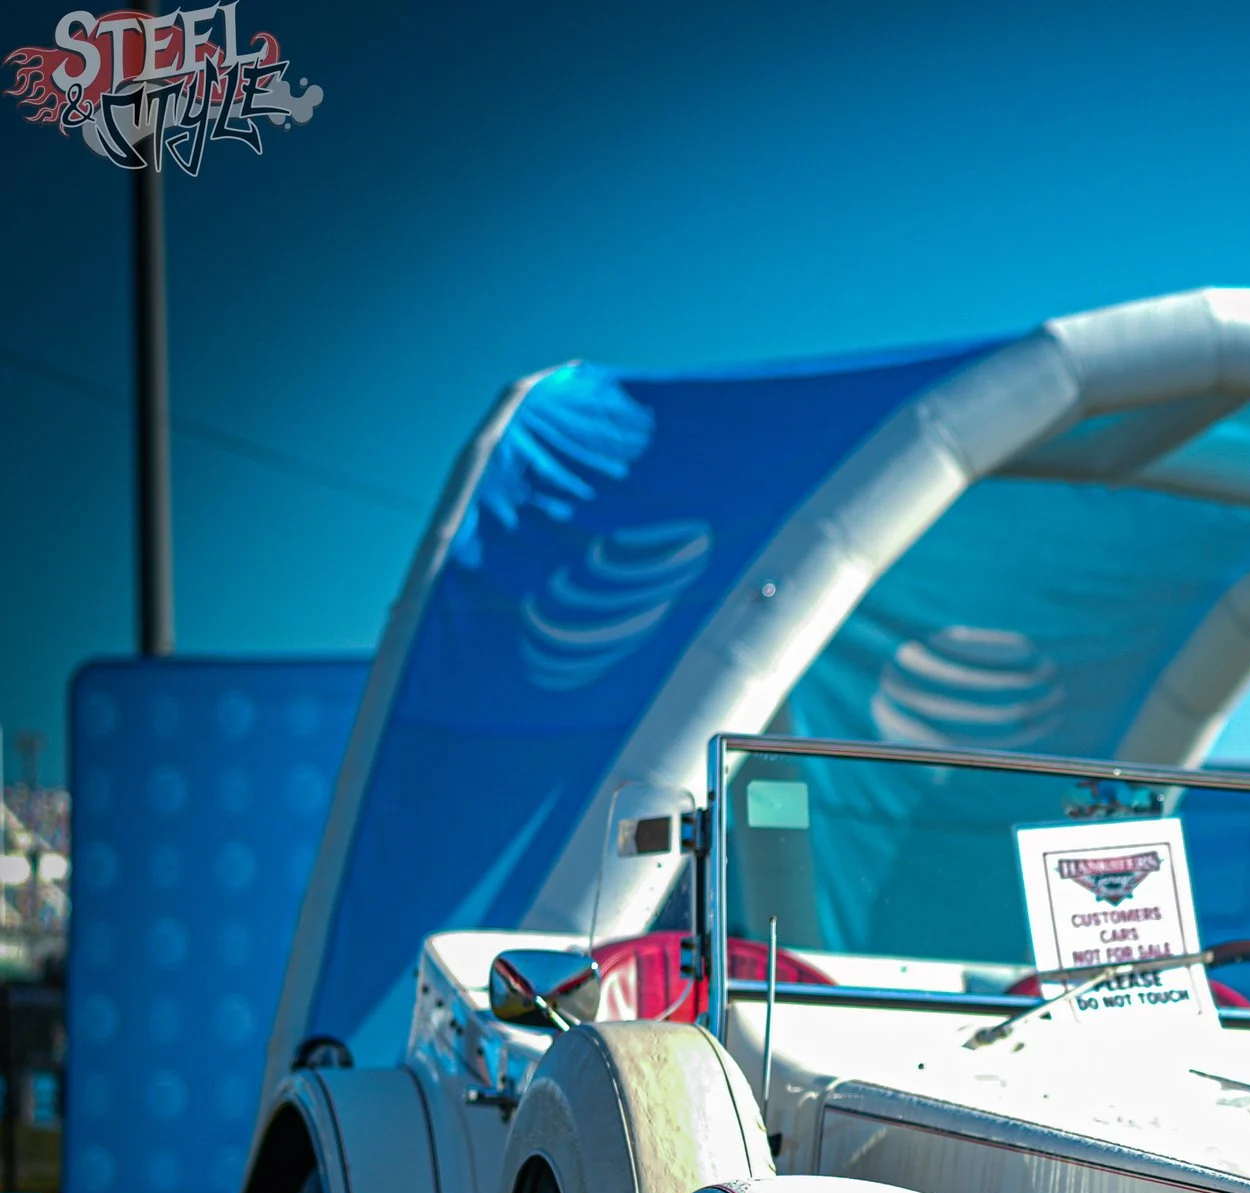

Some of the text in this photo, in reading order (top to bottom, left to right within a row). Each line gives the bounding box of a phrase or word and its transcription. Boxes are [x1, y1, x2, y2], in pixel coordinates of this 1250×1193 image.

[1071, 906, 1162, 928] CUSTOMERS
[1100, 927, 1139, 943] CARS
[1072, 949, 1100, 965] NOT
[1106, 946, 1133, 963] FOR
[1076, 989, 1189, 1010] DO NOT TOUCH
